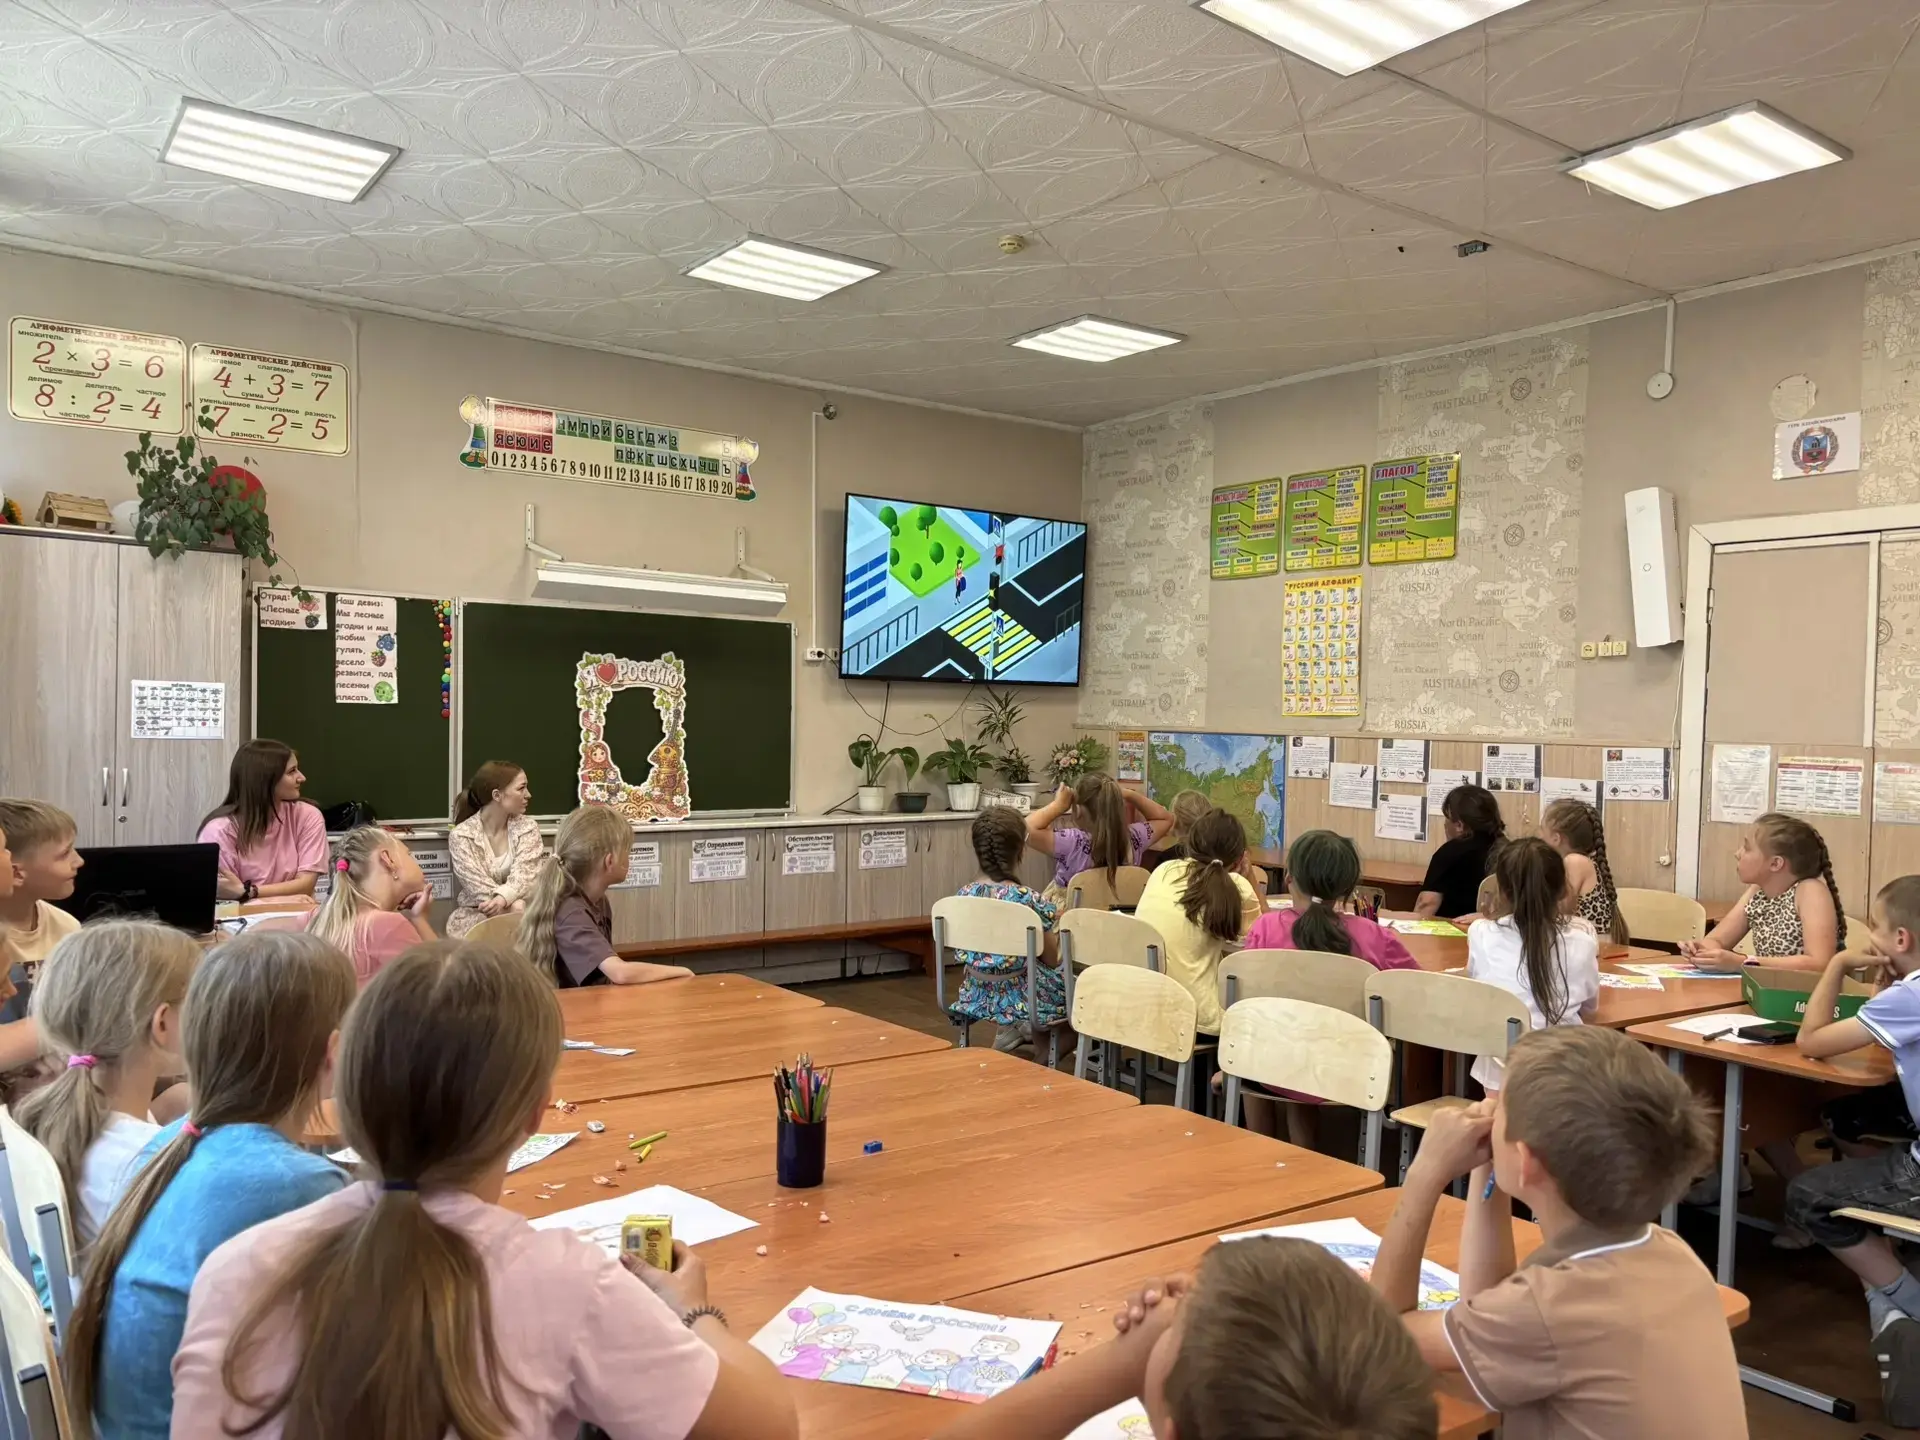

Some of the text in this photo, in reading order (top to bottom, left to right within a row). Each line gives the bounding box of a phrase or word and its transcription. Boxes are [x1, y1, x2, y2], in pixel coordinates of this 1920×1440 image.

[18, 331, 64, 342] множитель
[32, 341, 56, 365] 2
[91, 348, 111, 373] 3
[144, 356, 165, 379] 6
[210, 349, 332, 372] АРИФМЕТИЧЕСКИЕ ДЕЙСТВИЯ
[44, 365, 96, 377] произведение
[257, 364, 295, 374] слагаемое
[311, 372, 333, 380] сумма
[27, 375, 167, 398] делимое делитель частное
[213, 366, 233, 389] 4
[267, 374, 285, 396] 3
[314, 380, 330, 402] 7
[241, 391, 264, 400] сумма
[34, 384, 56, 407] 8
[93, 391, 115, 414] 2
[141, 397, 162, 420] 4
[199, 397, 337, 419] уменьшаемое вычитаемое разность
[59, 411, 91, 420] частное
[213, 406, 230, 428] 7
[267, 413, 287, 436] 2
[312, 418, 330, 440] 5
[230, 430, 265, 440] разность
[492, 451, 733, 495] 0 1 2 3 4 5 6 7 8 9 10 11 12 13 14 15 16 17 18 19 20
[1375, 464, 1415, 479] ГЛАГОЛ
[1289, 577, 1357, 590] РУССКИЙ АЛФАВИТ
[1399, 583, 1432, 593] RUSSIA
[260, 592, 290, 603] Отряд:
[336, 597, 354, 606] Наш
[379, 671, 394, 679] под
[581, 667, 600, 690] Я
[1422, 678, 1478, 689] AUSTRALIA
[1417, 706, 1436, 715] ASIA
[1394, 720, 1427, 730] RUSSIA
